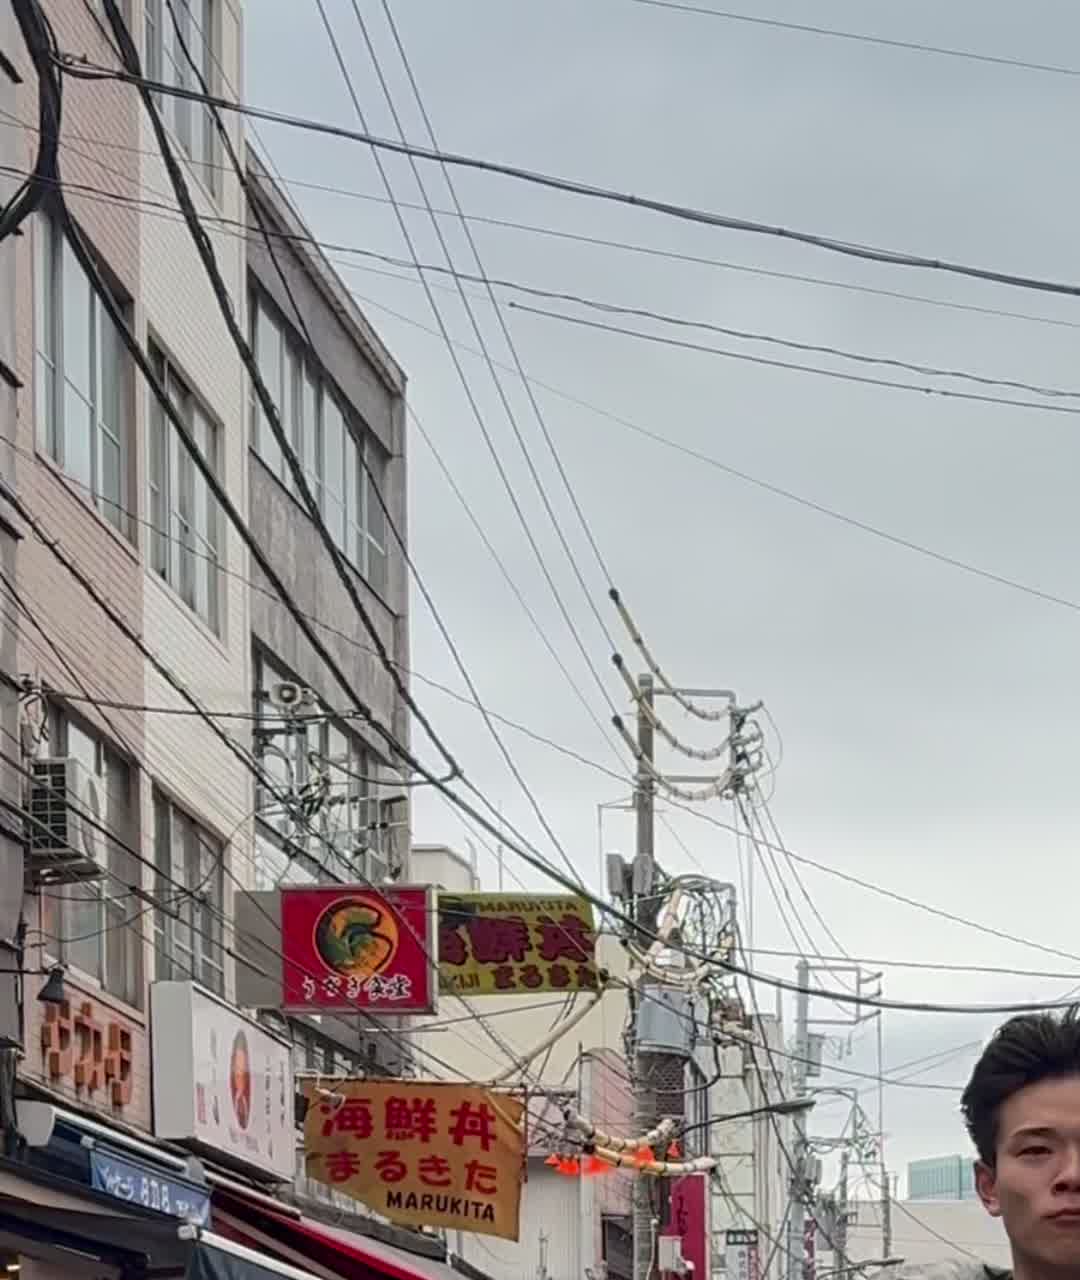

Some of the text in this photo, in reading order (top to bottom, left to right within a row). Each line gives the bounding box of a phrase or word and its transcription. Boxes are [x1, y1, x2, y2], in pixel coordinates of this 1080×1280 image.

[319, 1096, 497, 1151] 海鮮丼
[324, 1150, 498, 1195] まるきた
[386, 1190, 496, 1224] MARUKITA
